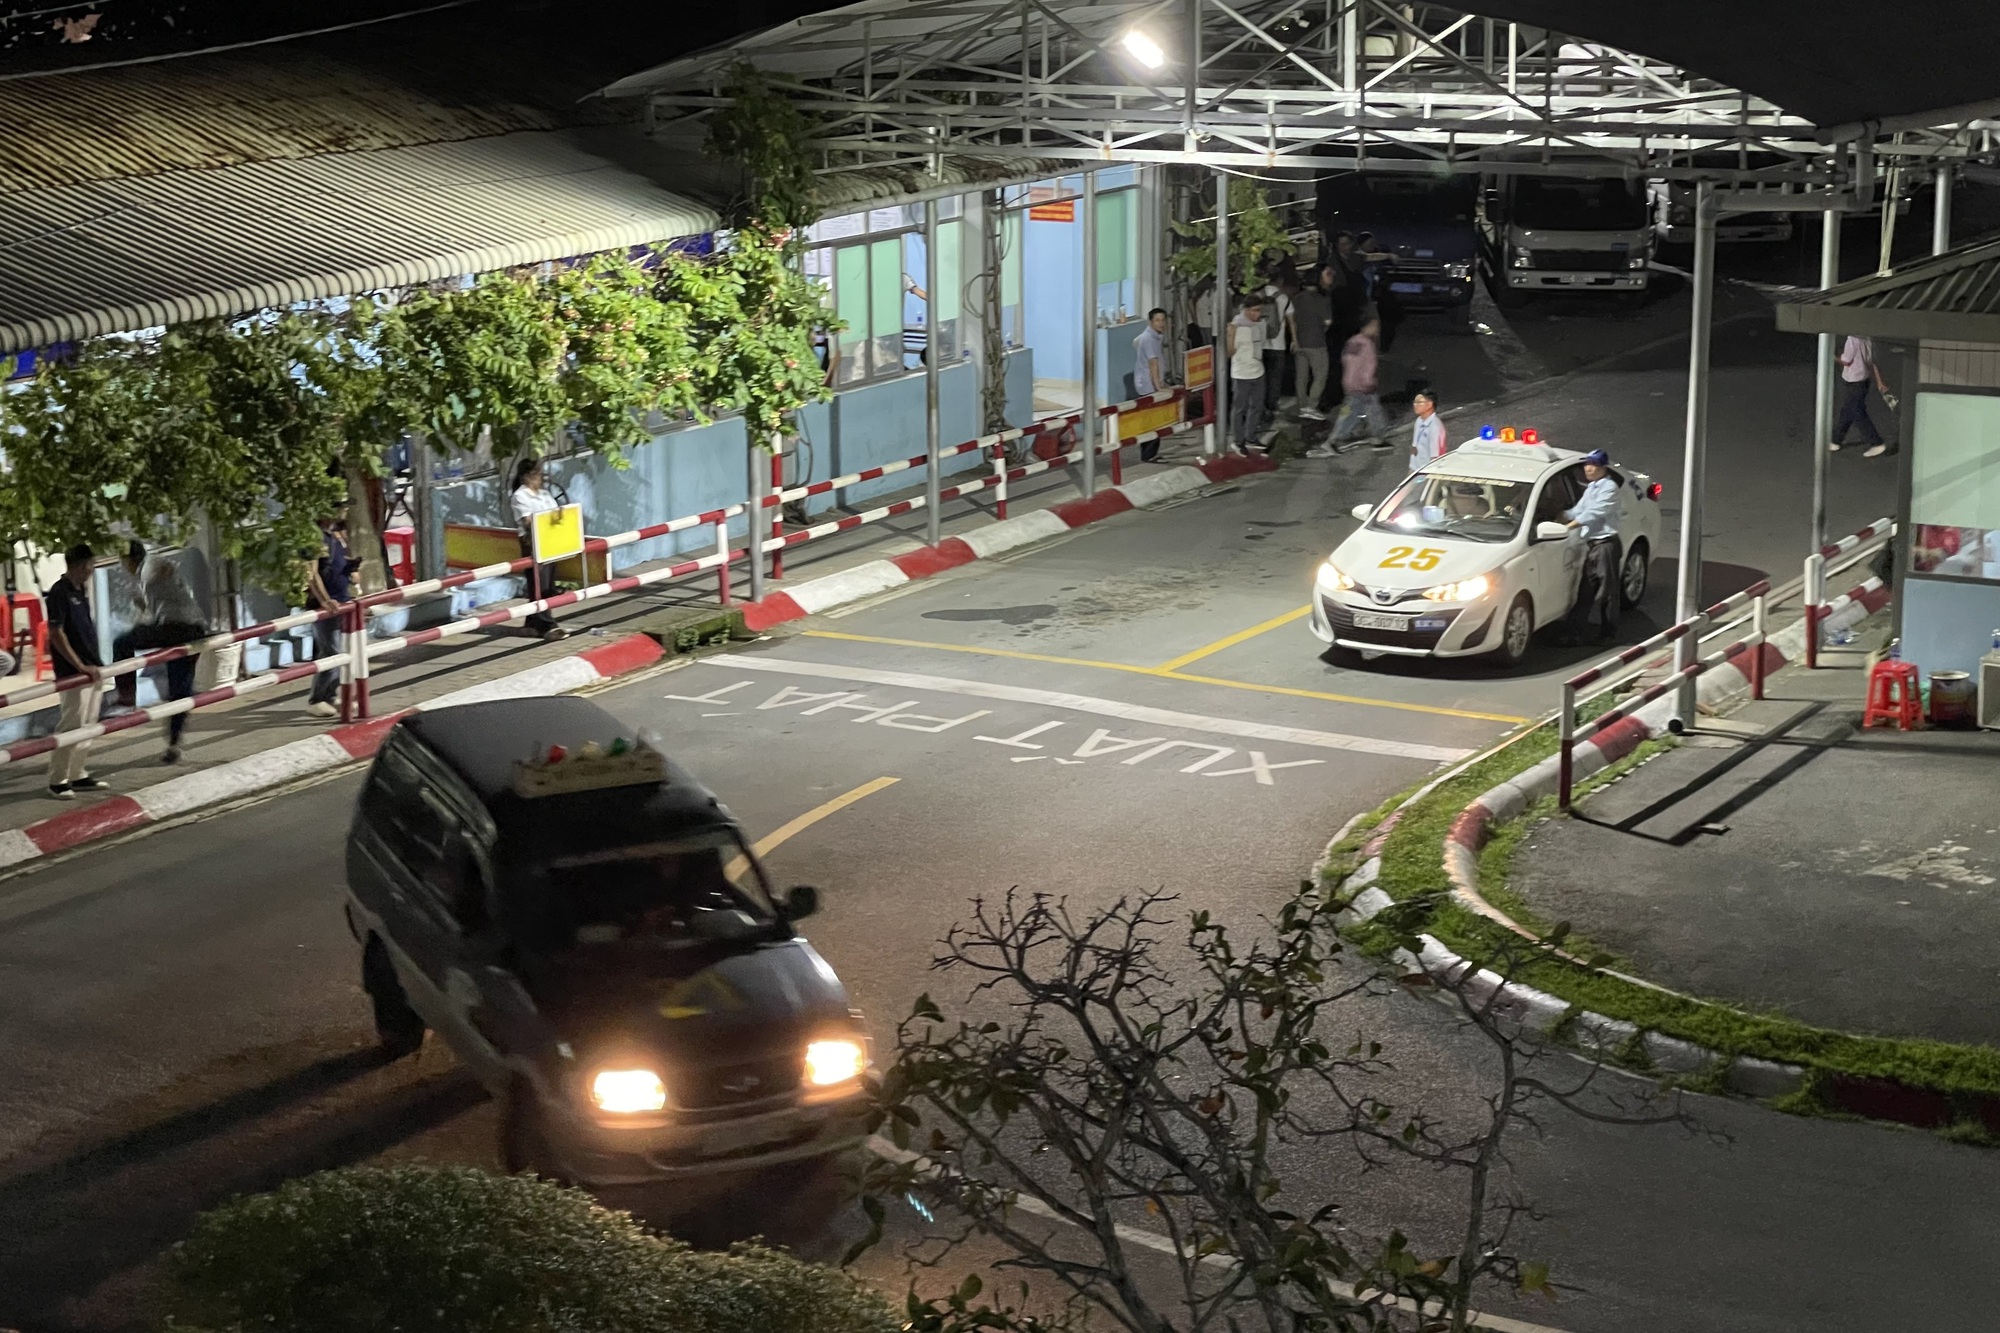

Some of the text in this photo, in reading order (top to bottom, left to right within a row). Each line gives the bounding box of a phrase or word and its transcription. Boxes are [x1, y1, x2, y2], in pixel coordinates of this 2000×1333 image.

[1377, 546, 1449, 572] 25
[663, 680, 1327, 785] XUẤT PHÁT
